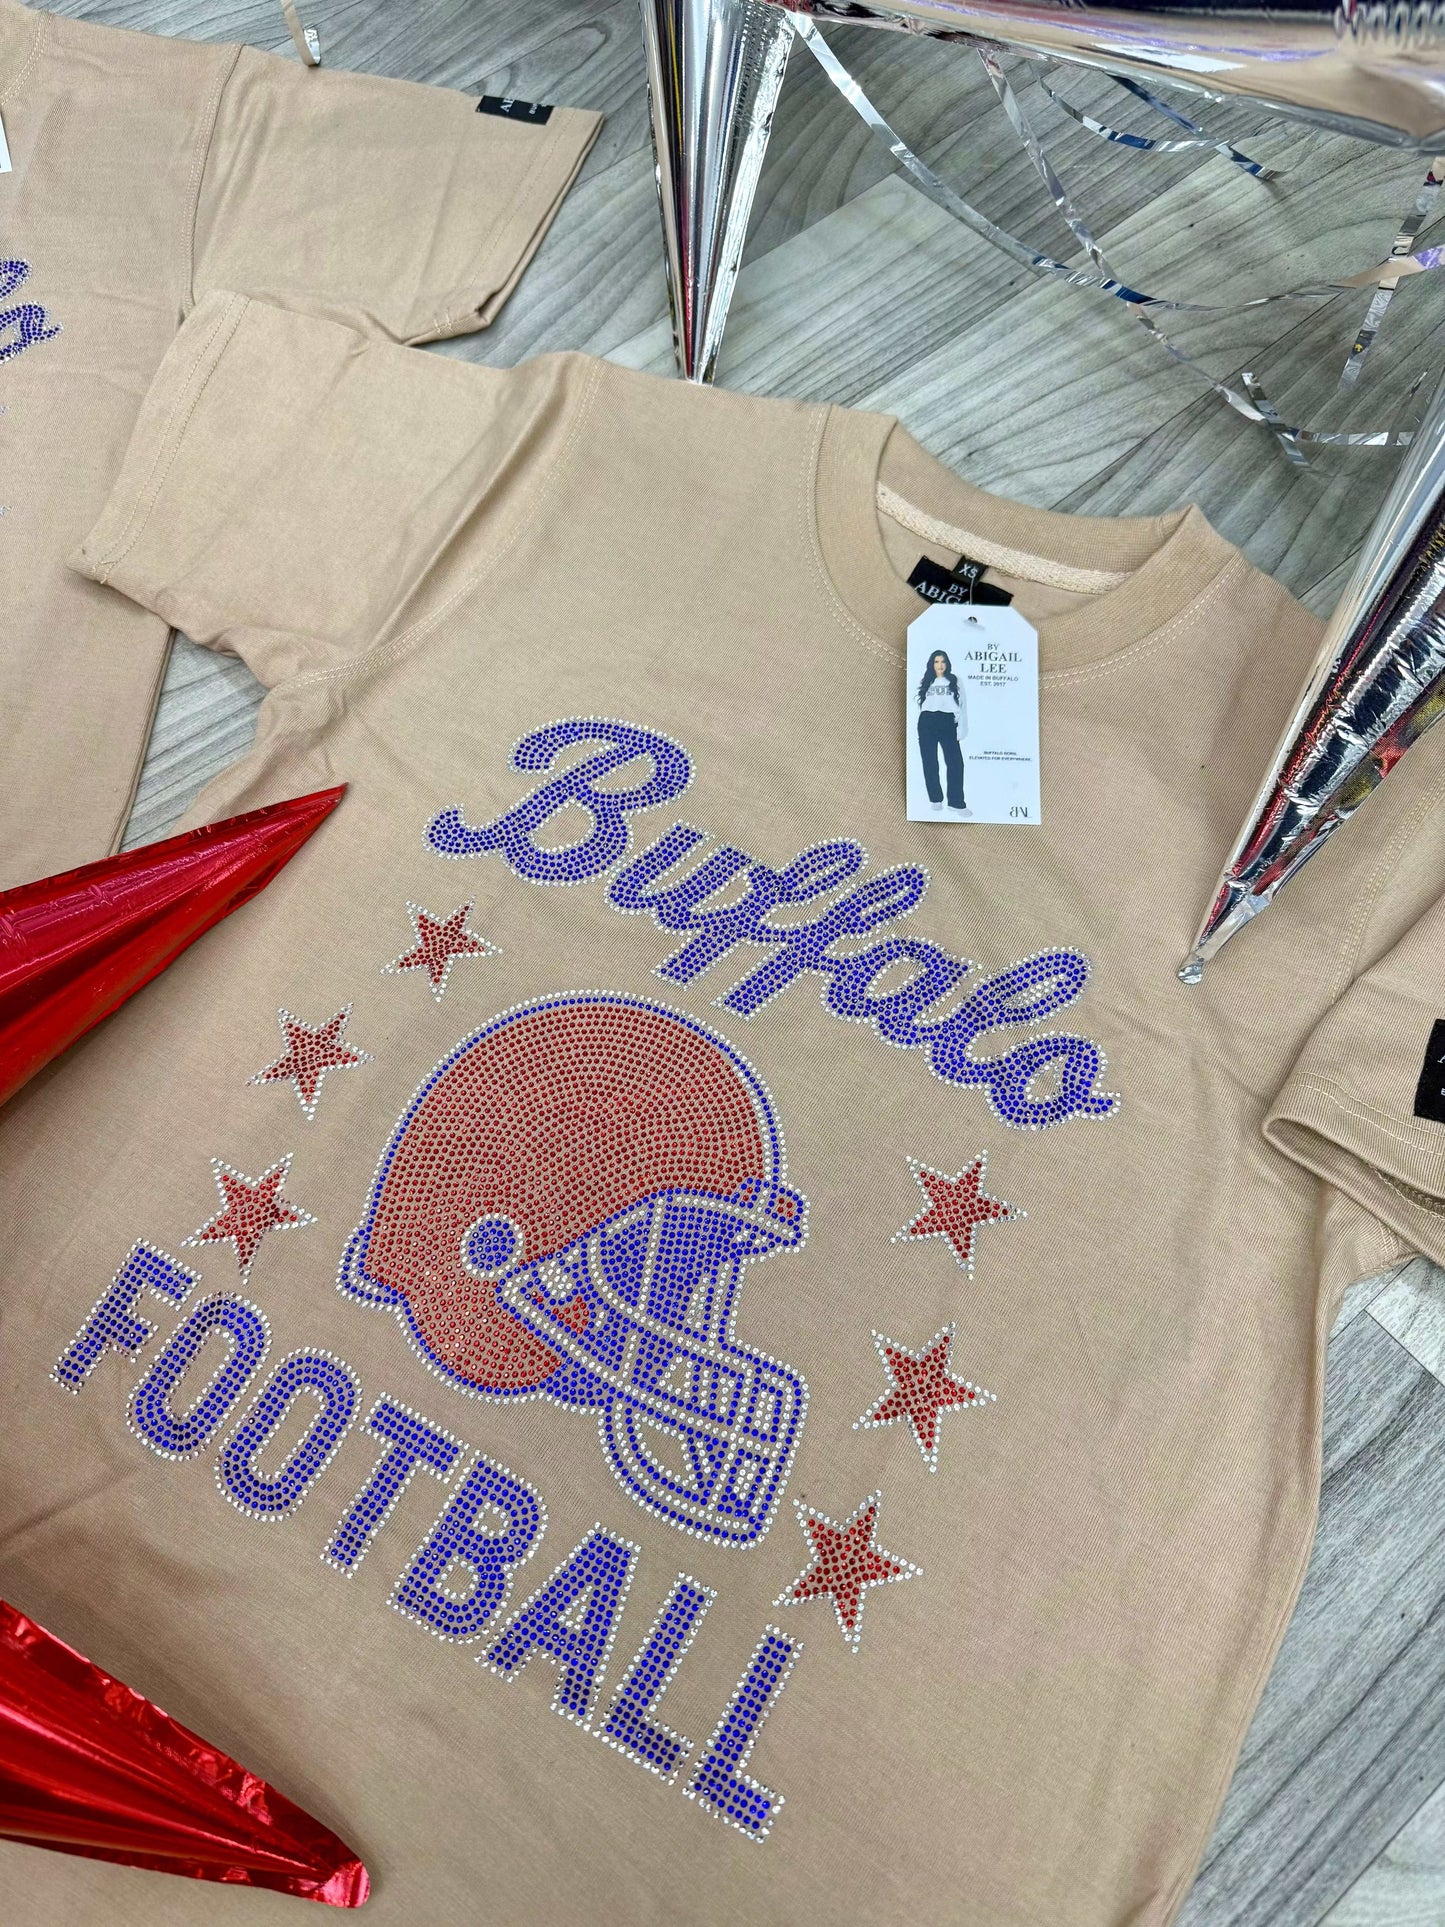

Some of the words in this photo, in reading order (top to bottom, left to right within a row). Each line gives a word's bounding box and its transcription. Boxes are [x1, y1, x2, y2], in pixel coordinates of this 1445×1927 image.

[959, 563, 978, 579] XS
[948, 583, 968, 597] BY
[987, 643, 999, 651] BY
[964, 651, 1022, 662] ABIGAIL
[980, 663, 1007, 674] LEE
[423, 716, 1121, 1130] Buffalo
[49, 1238, 803, 1843] FOOTBALL
